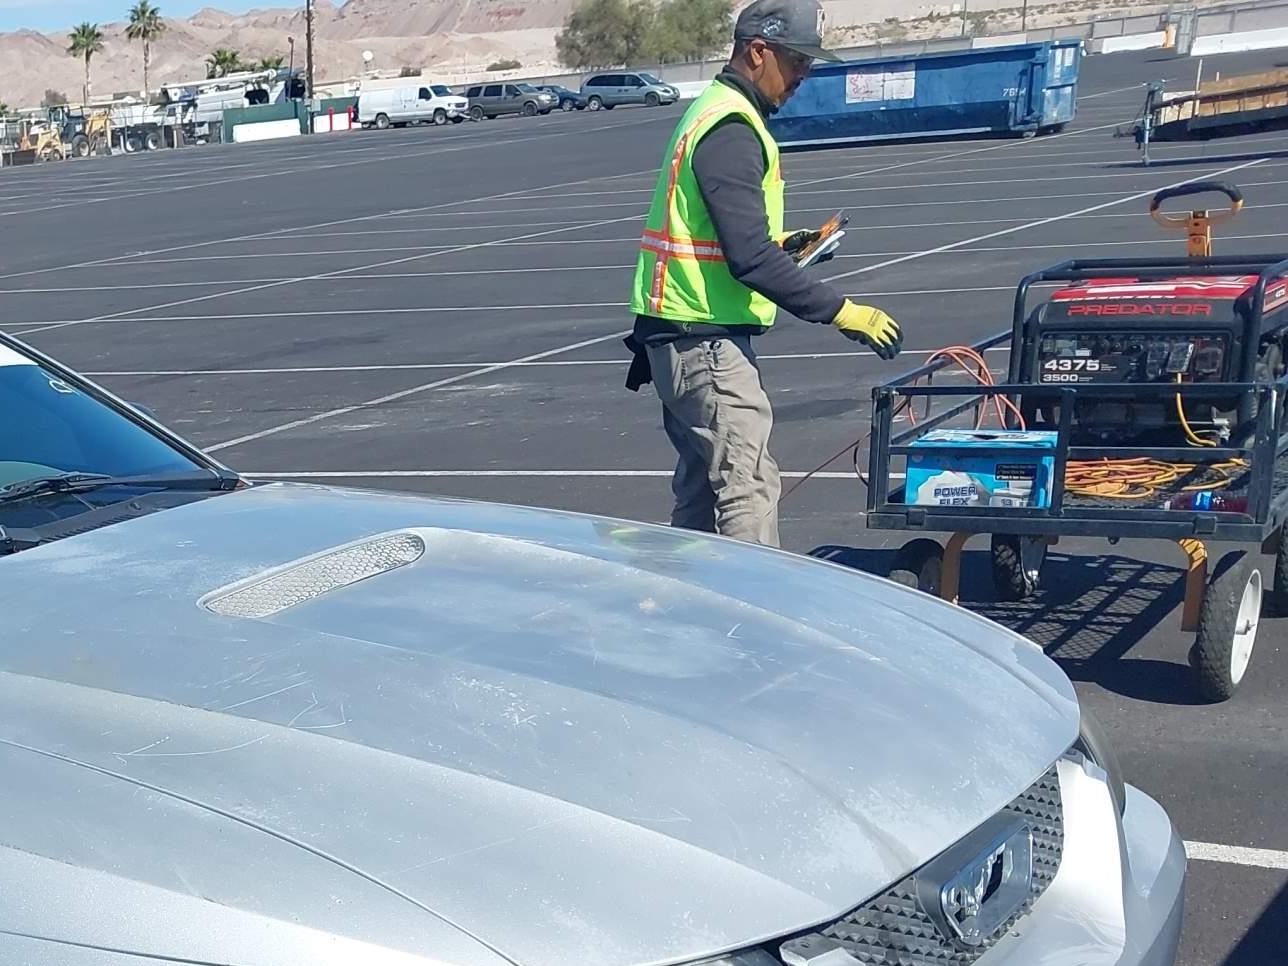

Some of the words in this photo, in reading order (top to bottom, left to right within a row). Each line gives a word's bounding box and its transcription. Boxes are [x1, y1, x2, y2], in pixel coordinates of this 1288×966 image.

[1066, 303, 1212, 317] PREDATOR
[1044, 359, 1100, 371] 4375
[1042, 374, 1079, 382] 3500
[933, 486, 978, 498] POWER
